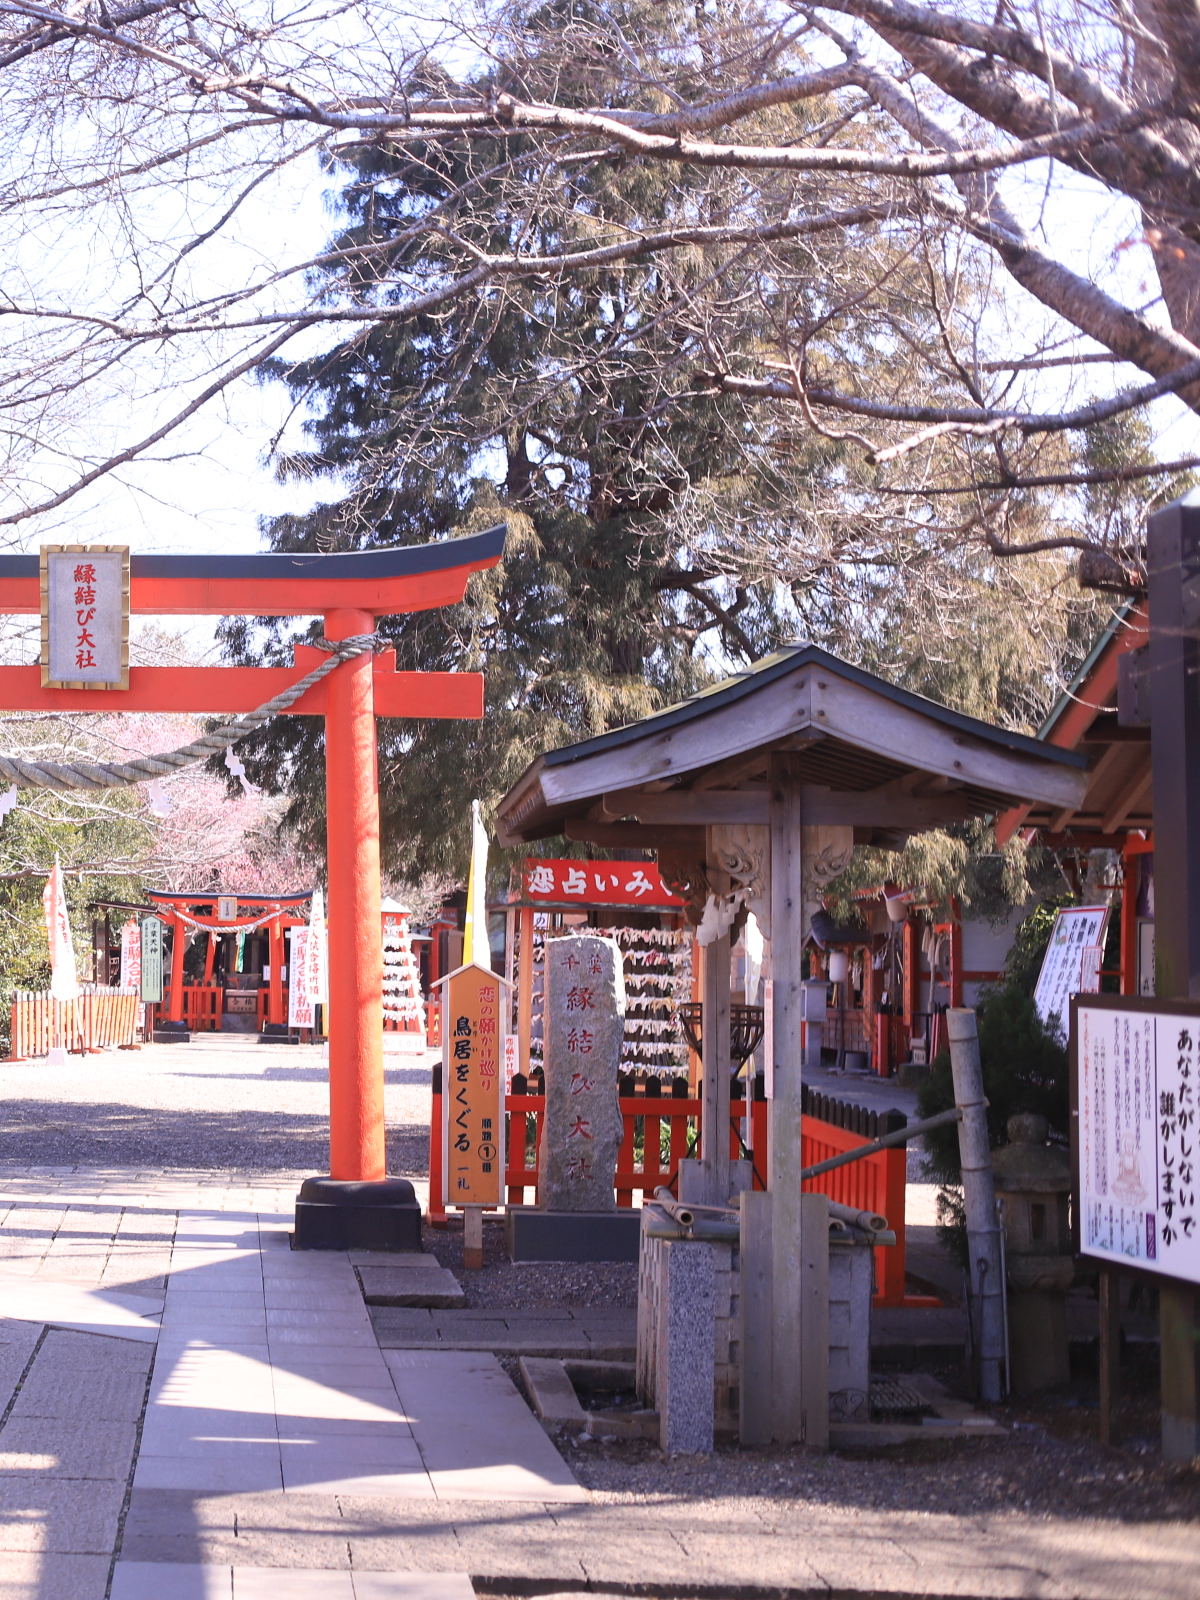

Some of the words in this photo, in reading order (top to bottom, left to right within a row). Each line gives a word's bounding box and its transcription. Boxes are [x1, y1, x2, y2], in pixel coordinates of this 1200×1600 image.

[73, 563, 97, 669] 縁結び大社
[527, 865, 690, 898] 恋占いみ
[453, 1016, 472, 1152] 鳥居をくぐる
[479, 986, 496, 1092] 恋の願かけ巡り
[565, 986, 597, 1181] 縁結び大社
[457, 1166, 470, 1190] 一礼
[1160, 1089, 1178, 1248] 誰がしますか
[1177, 1027, 1197, 1239] あなたがしないで
